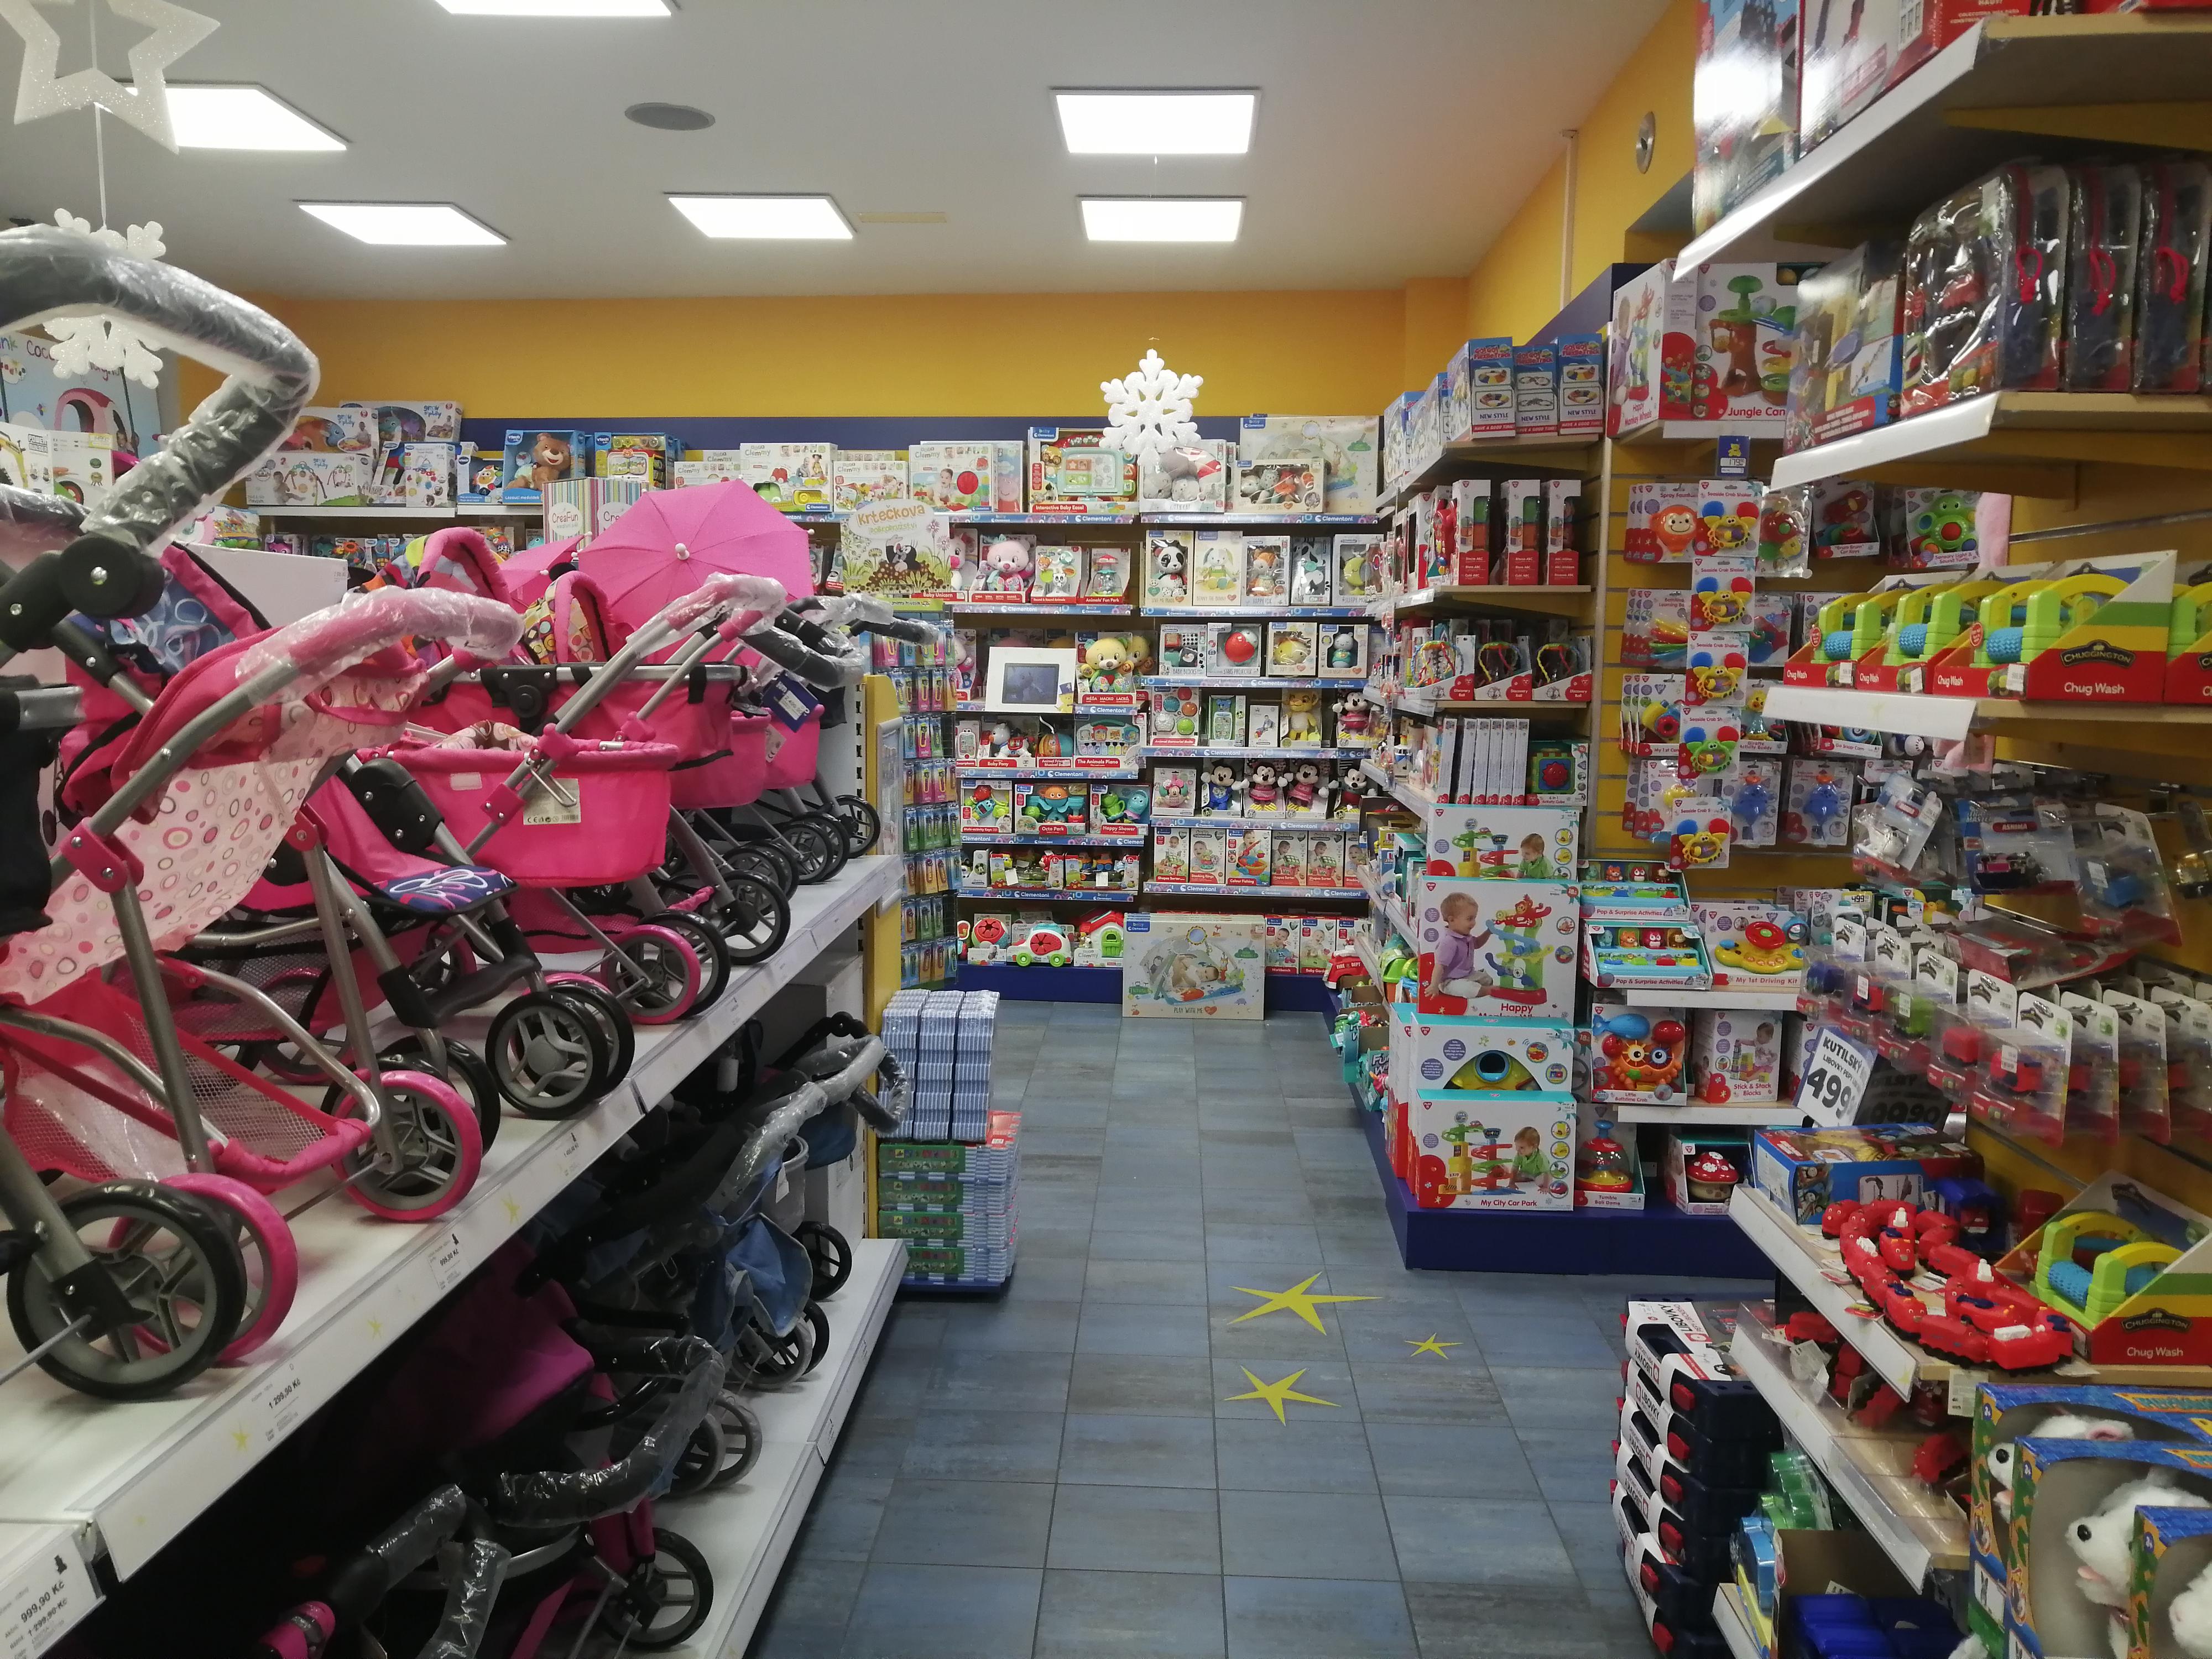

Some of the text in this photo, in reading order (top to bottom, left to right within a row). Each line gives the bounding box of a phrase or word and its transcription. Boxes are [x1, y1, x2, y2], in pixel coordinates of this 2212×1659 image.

[1728, 407, 1762, 416] Jungle
[745, 448, 771, 457] Clemmy
[552, 511, 579, 524] CreaFun
[858, 503, 926, 526] Krtečkova
[2063, 649, 2132, 664] CHUGGINGTON
[1787, 670, 1808, 679] Chug Wash
[1860, 674, 1880, 684] Chug Wash
[1937, 675, 1964, 687] Chug Wash
[2064, 682, 2125, 696] Chug Wash
[1761, 977, 1786, 985] Driving
[1501, 1003, 1533, 1013] Happy
[1823, 1036, 1863, 1073] KUTILSKÝ
[1823, 1054, 1844, 1073] LIBOVKY
[1658, 1304, 1693, 1332] LIBOVKY
[2125, 1317, 2189, 1329] CHUGGINGTON
[2127, 1347, 2184, 1359] Chug Wash
[1634, 1347, 1653, 1378] LIBOVKY
[292, 1377, 301, 1389] Kč
[1641, 1388, 1660, 1420] LIBOVKY
[20, 1592, 51, 1623] 999,90
[51, 1579, 65, 1595] Kč
